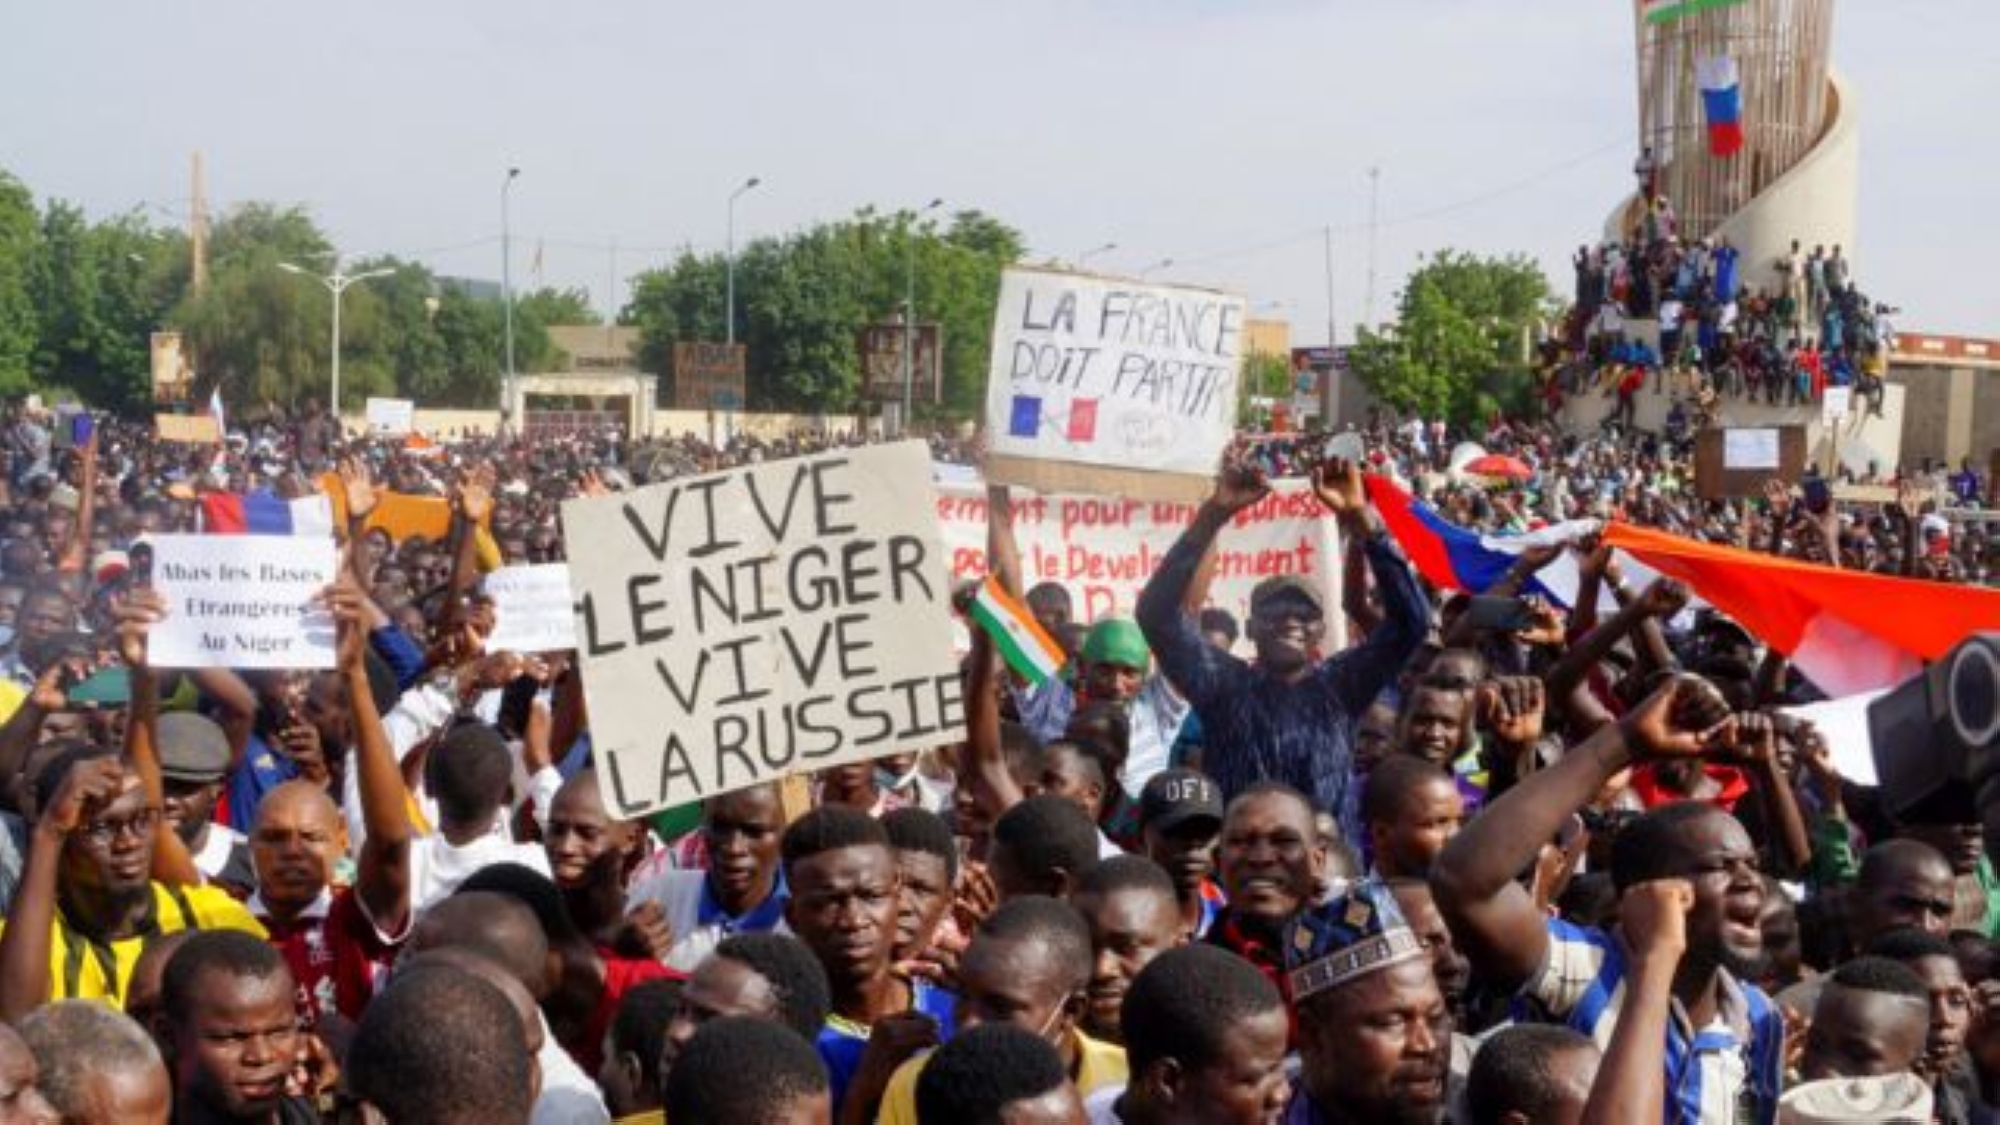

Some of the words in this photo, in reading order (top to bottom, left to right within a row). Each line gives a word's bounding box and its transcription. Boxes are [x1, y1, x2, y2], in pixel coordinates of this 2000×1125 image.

[1022, 288, 1077, 333] LA
[1098, 291, 1242, 358] FRANCE
[622, 458, 857, 562] VIVE
[1061, 498, 1144, 541] pour
[162, 562, 211, 582] Abas
[219, 562, 251, 582] les
[259, 563, 324, 583] Bases
[1033, 543, 1059, 578] le
[573, 574, 674, 658] LE
[690, 534, 934, 634] NIGER
[199, 632, 226, 651] Au
[235, 632, 294, 654] Niger
[656, 613, 877, 715] VIVE
[607, 731, 703, 815] LA
[713, 671, 967, 788] RUSSIE
